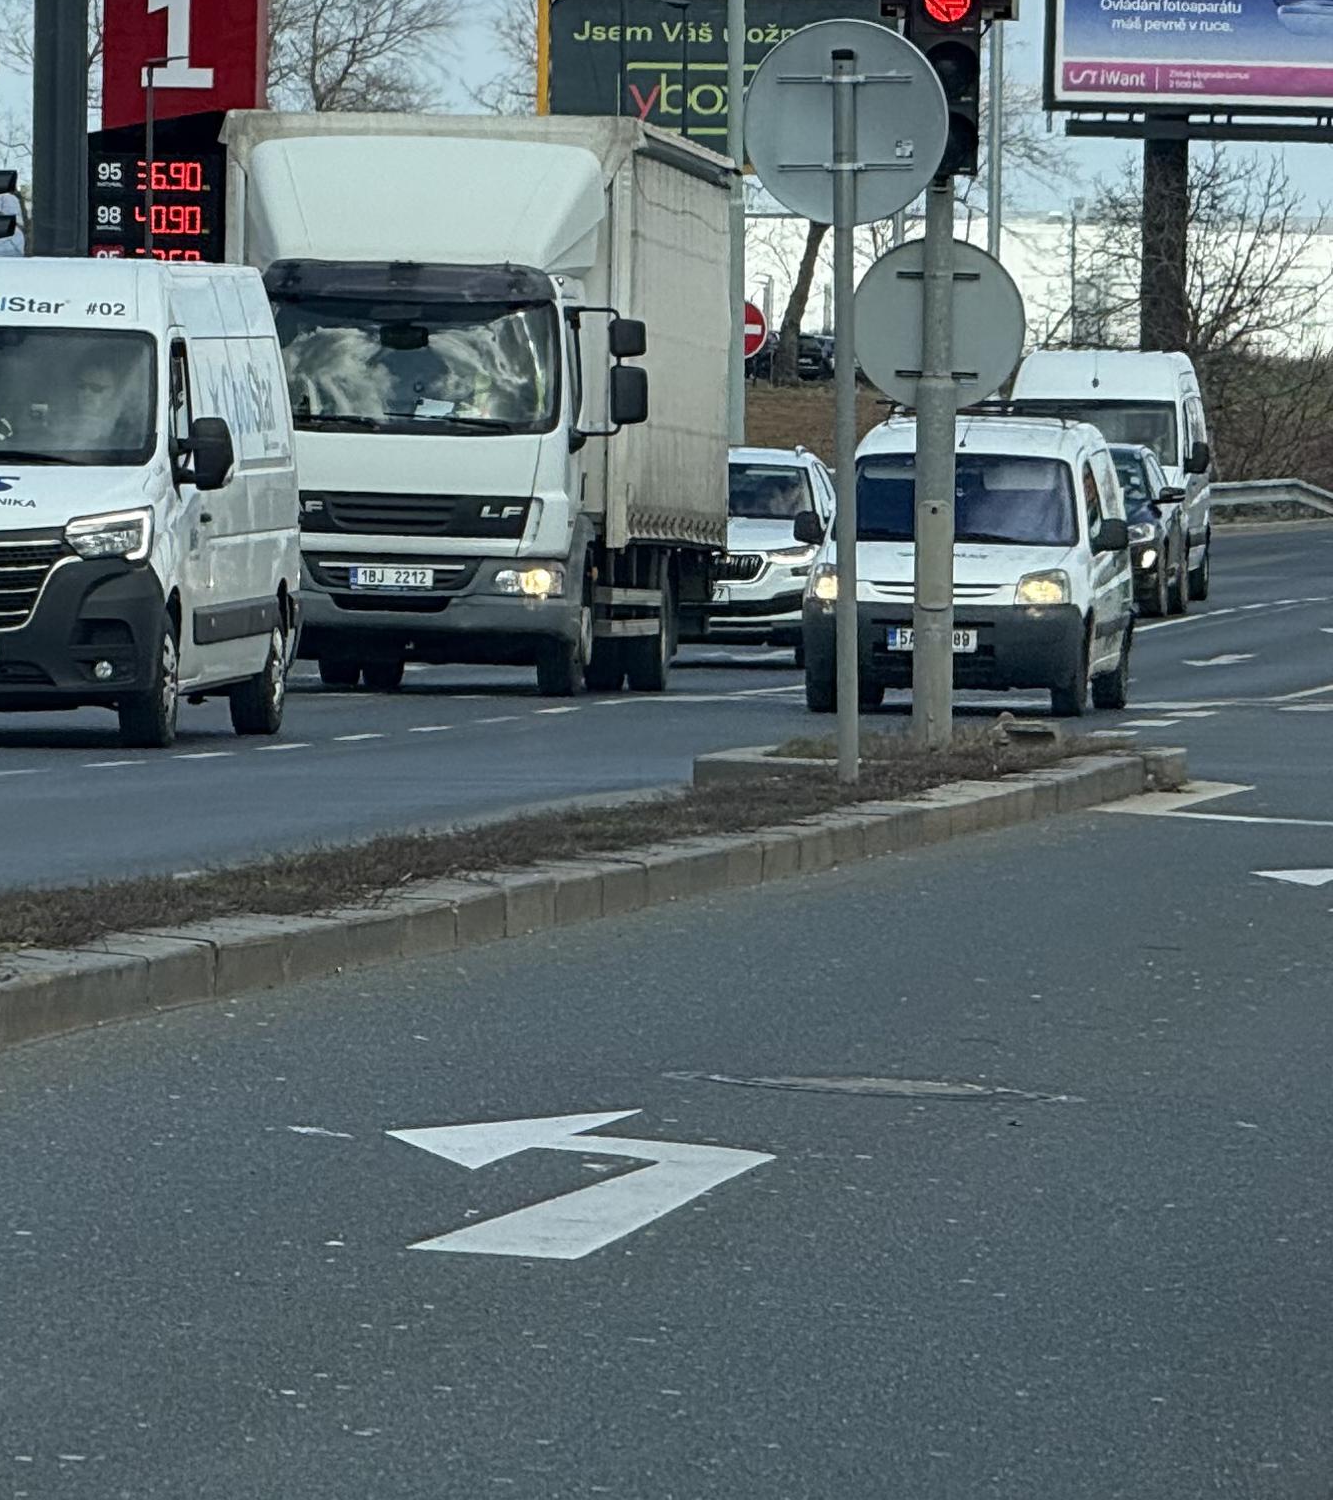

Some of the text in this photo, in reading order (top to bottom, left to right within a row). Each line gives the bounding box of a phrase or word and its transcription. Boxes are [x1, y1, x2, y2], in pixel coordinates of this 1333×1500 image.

[573, 21, 653, 42] Jsem
[661, 21, 713, 43] Váš
[1144, 19, 1186, 32] pevně
[1189, 21, 1198, 30] v
[1100, 69, 1146, 87] iWant
[98, 162, 122, 181] 95
[97, 205, 121, 224] 98
[85, 303, 126, 317] #02
[481, 506, 524, 519] LF
[394, 570, 427, 585] 2212
